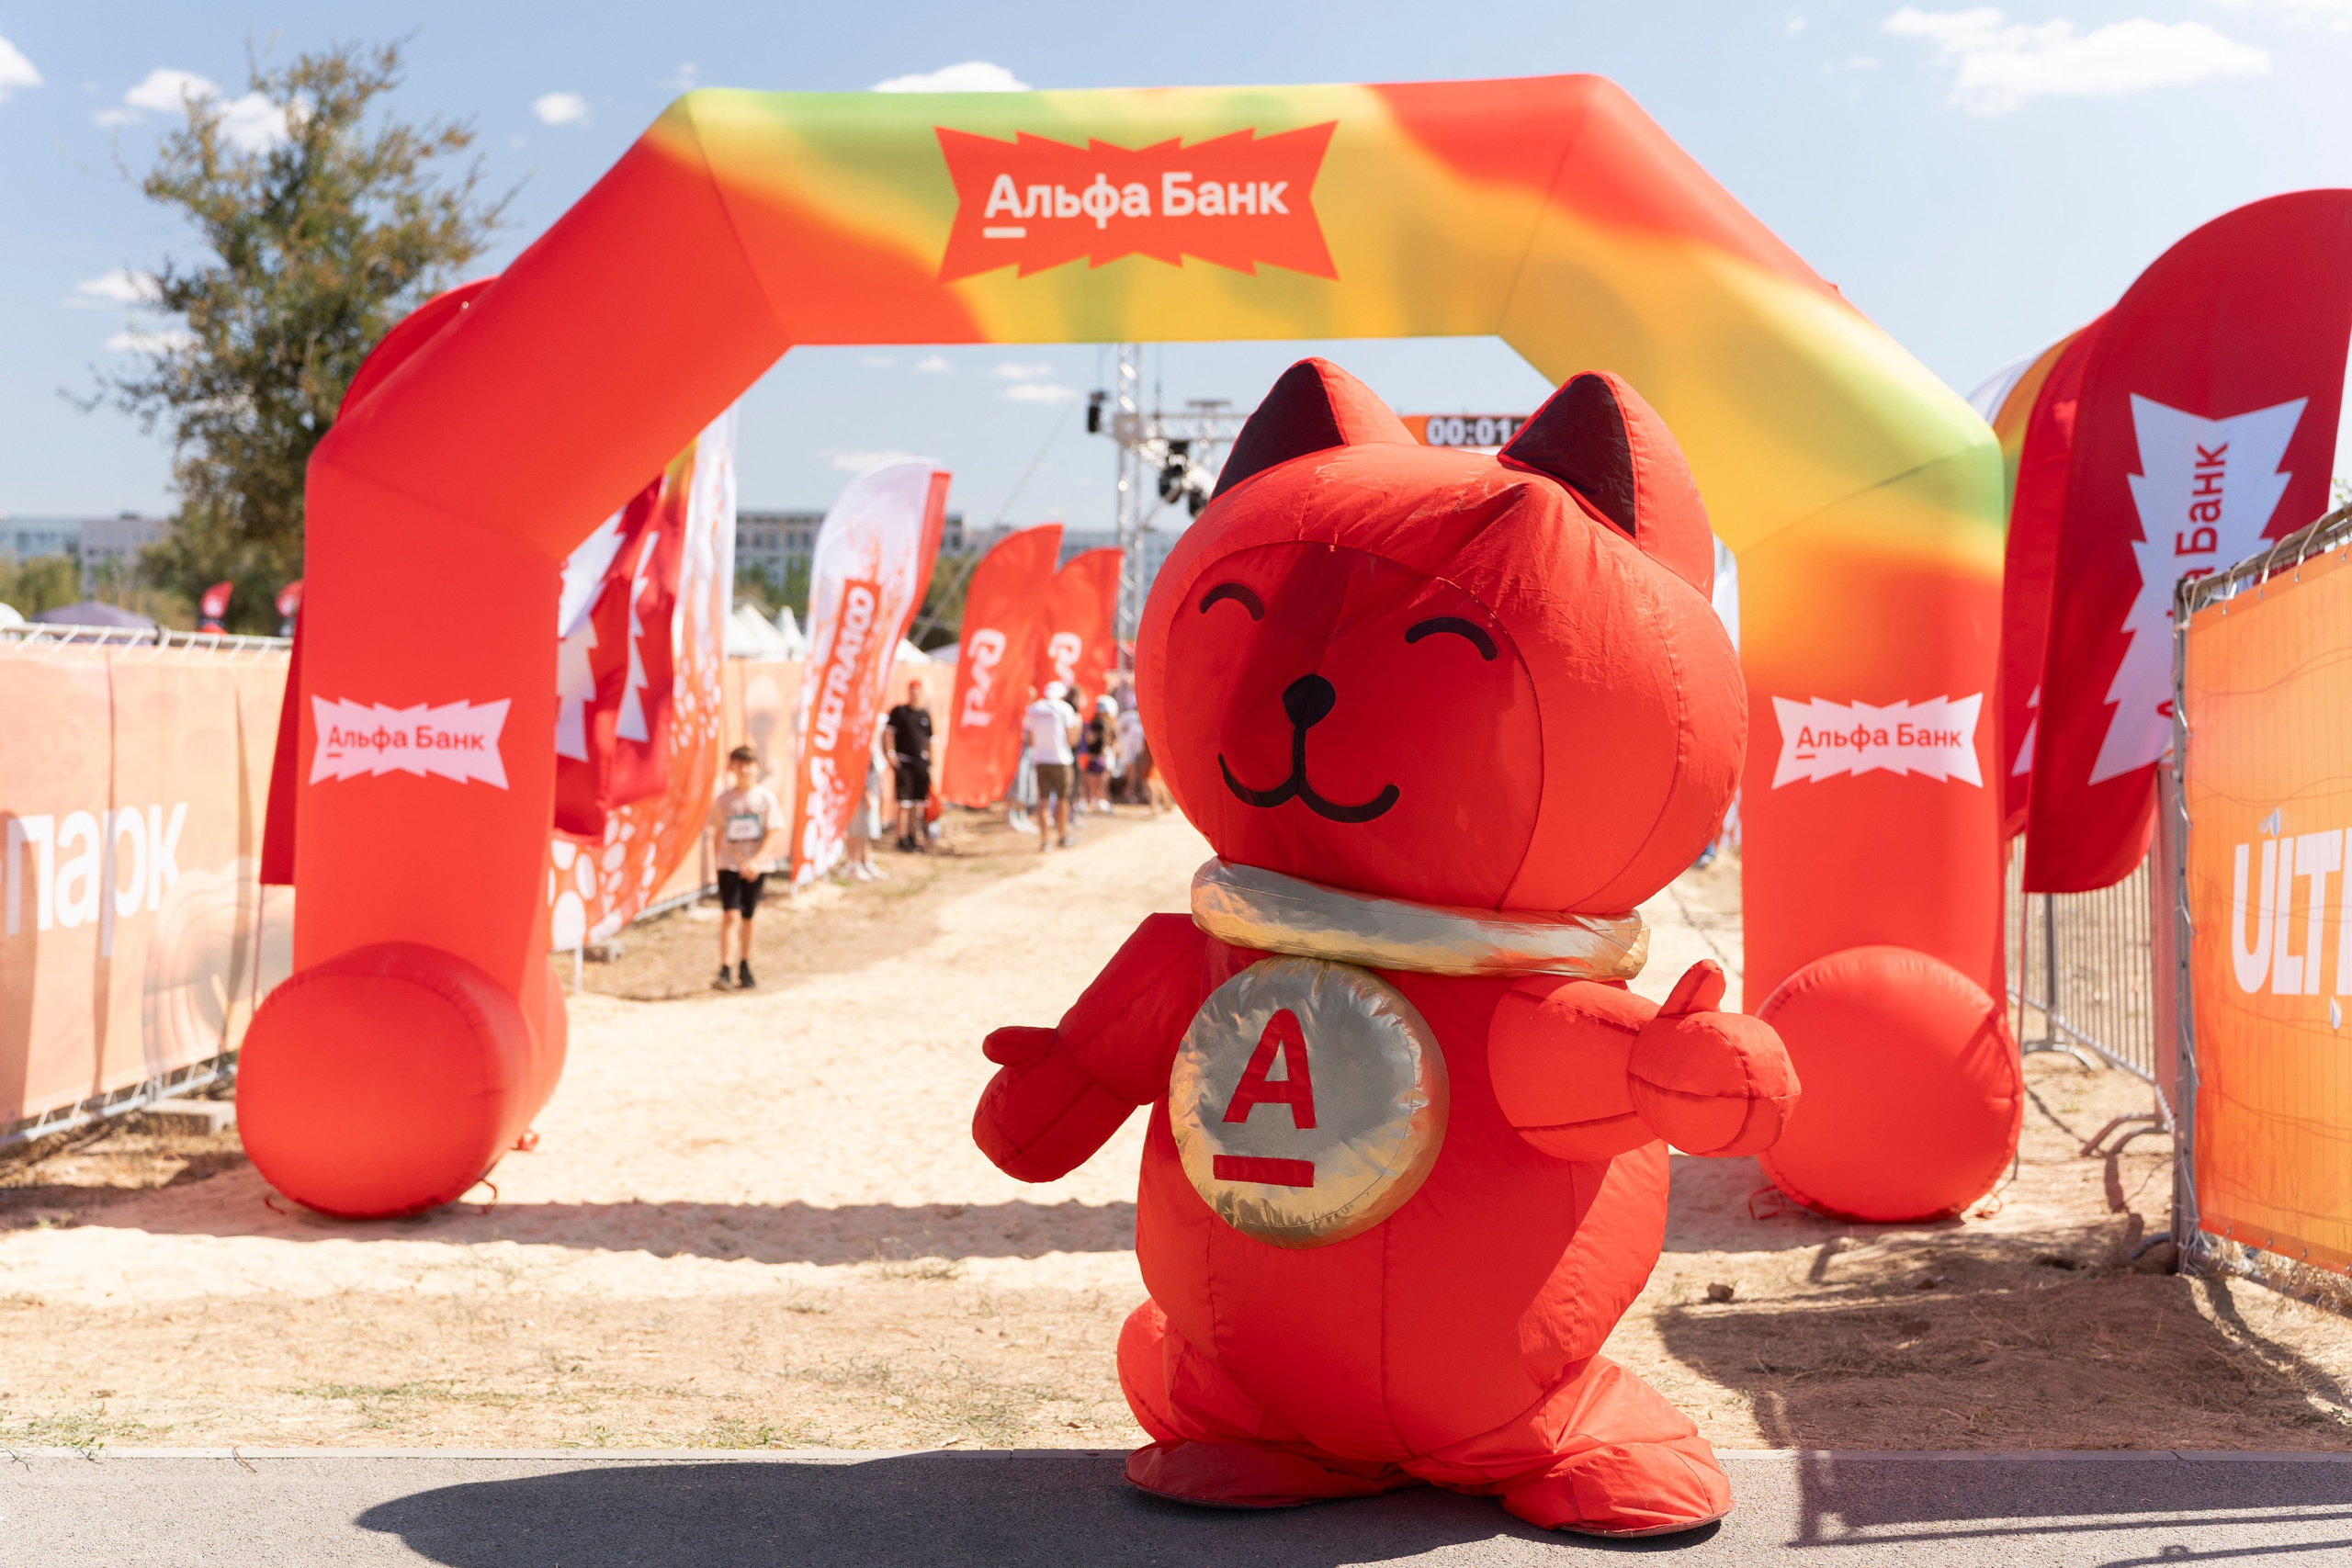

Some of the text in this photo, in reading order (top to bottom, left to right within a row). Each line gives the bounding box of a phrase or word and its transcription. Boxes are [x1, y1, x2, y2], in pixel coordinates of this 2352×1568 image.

[983, 172, 1289, 237] Альфа Банк
[1426, 417, 1522, 447] 00:01
[2174, 441, 2230, 558] Банк
[327, 724, 485, 759] Альфа Банк
[1796, 723, 1962, 759] Альфа Банк
[0, 801, 188, 960] парк
